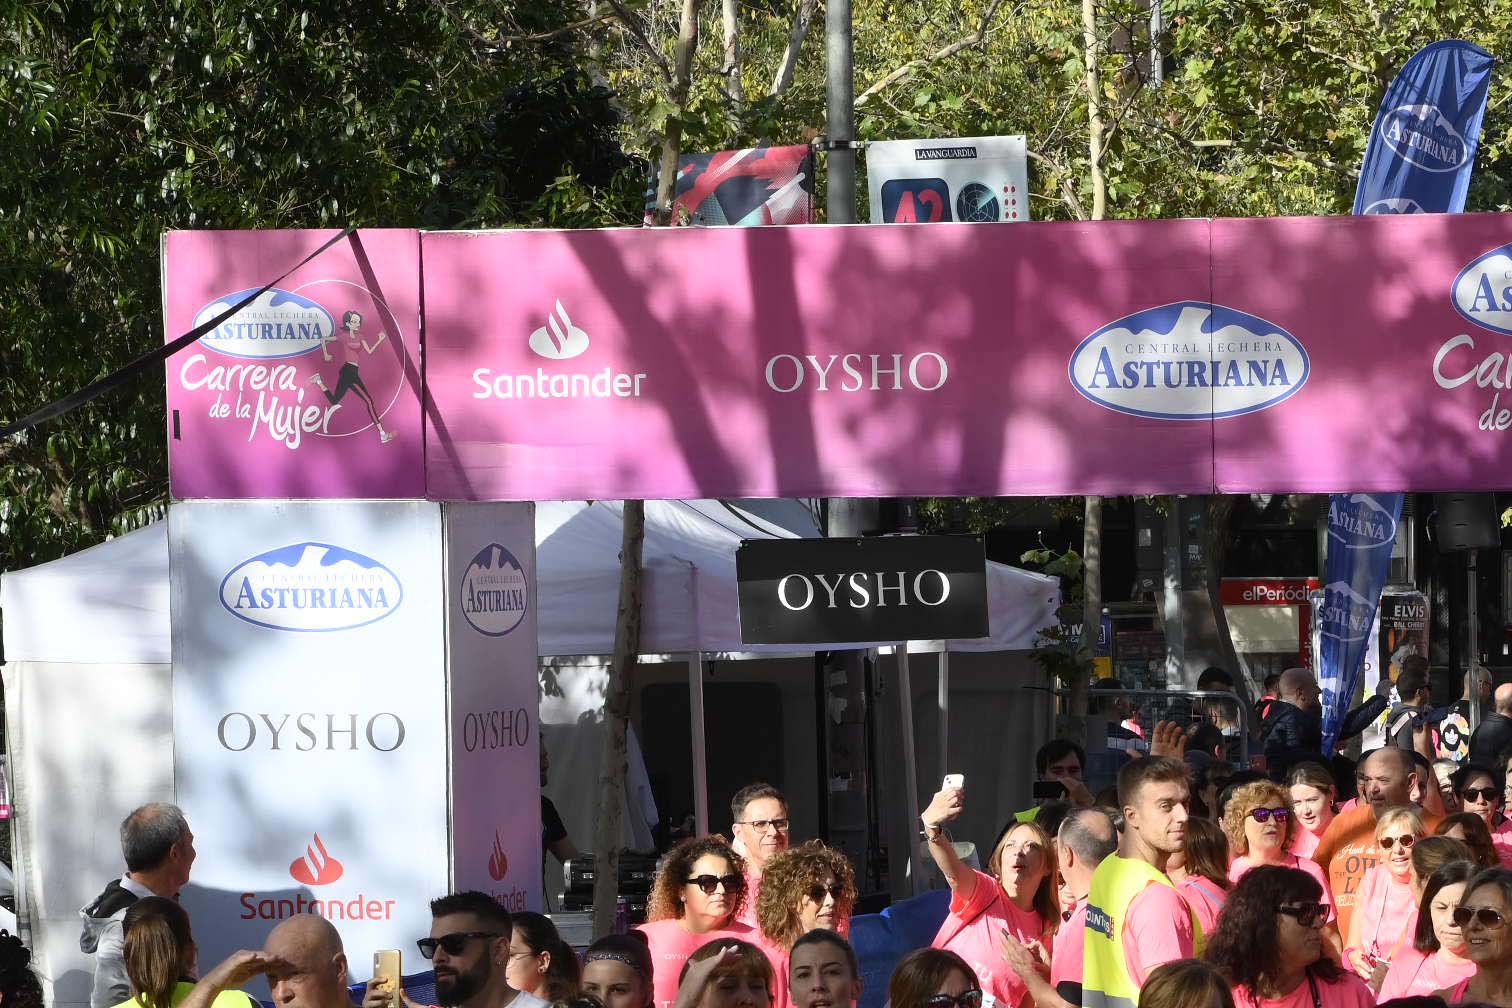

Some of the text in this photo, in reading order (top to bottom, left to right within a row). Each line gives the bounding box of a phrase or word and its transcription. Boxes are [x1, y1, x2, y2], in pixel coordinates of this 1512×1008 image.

[1124, 341, 1283, 354] CENTRAL LECHERA
[180, 353, 298, 392] Carrera
[472, 367, 647, 399] Santander
[764, 351, 949, 393] OYSHO
[1087, 345, 1293, 390] ASTURIANA
[209, 386, 343, 450] de la Mujer
[1478, 392, 1512, 431] de
[233, 576, 390, 610] ASTURIANA
[466, 577, 525, 614] ASTURIANA
[777, 568, 951, 612] OYSHO
[1394, 604, 1425, 618] ELVIS
[217, 712, 406, 752] OYSHO
[463, 707, 530, 753] OYSHO
[240, 892, 396, 921] Santander
